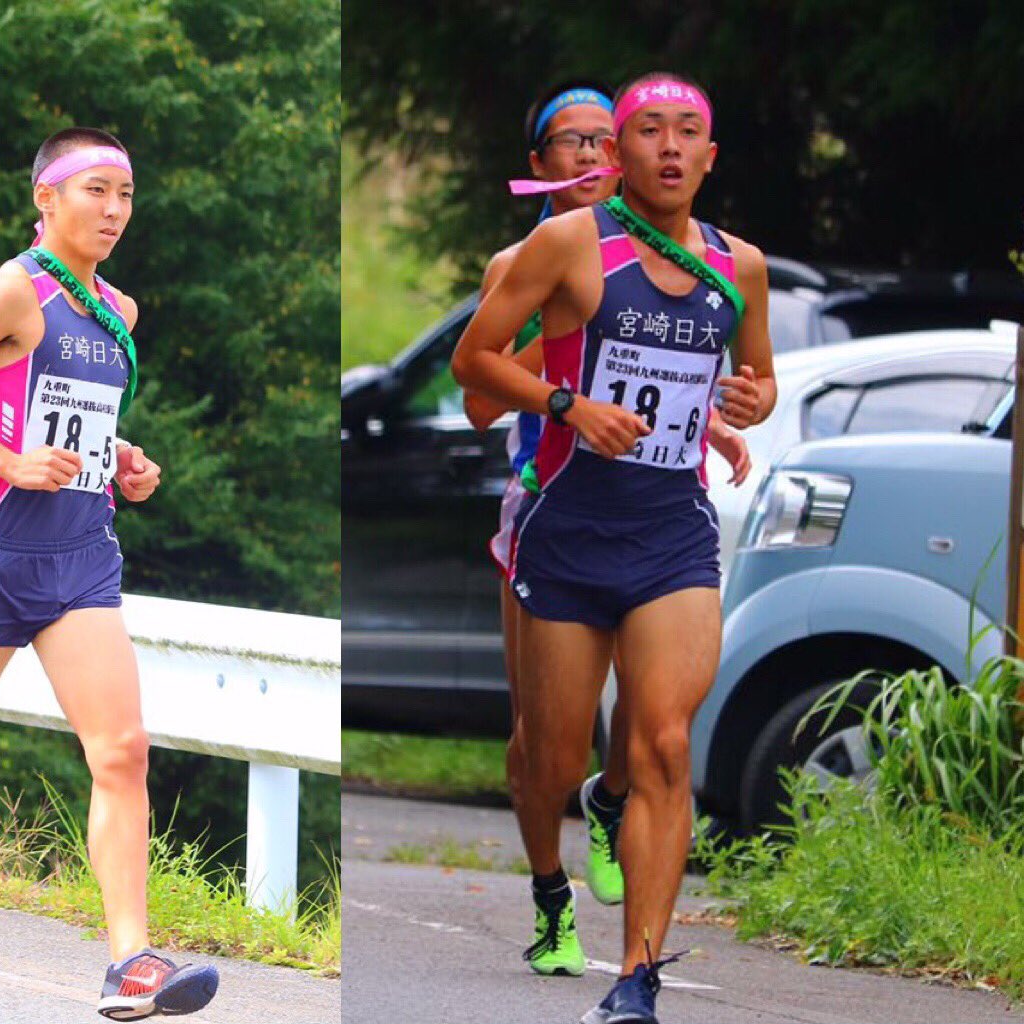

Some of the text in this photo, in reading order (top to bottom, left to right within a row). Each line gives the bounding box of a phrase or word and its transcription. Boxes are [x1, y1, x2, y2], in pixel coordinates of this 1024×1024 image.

[616, 306, 721, 348] 宮崎日大
[58, 332, 125, 370] 宮崎日大
